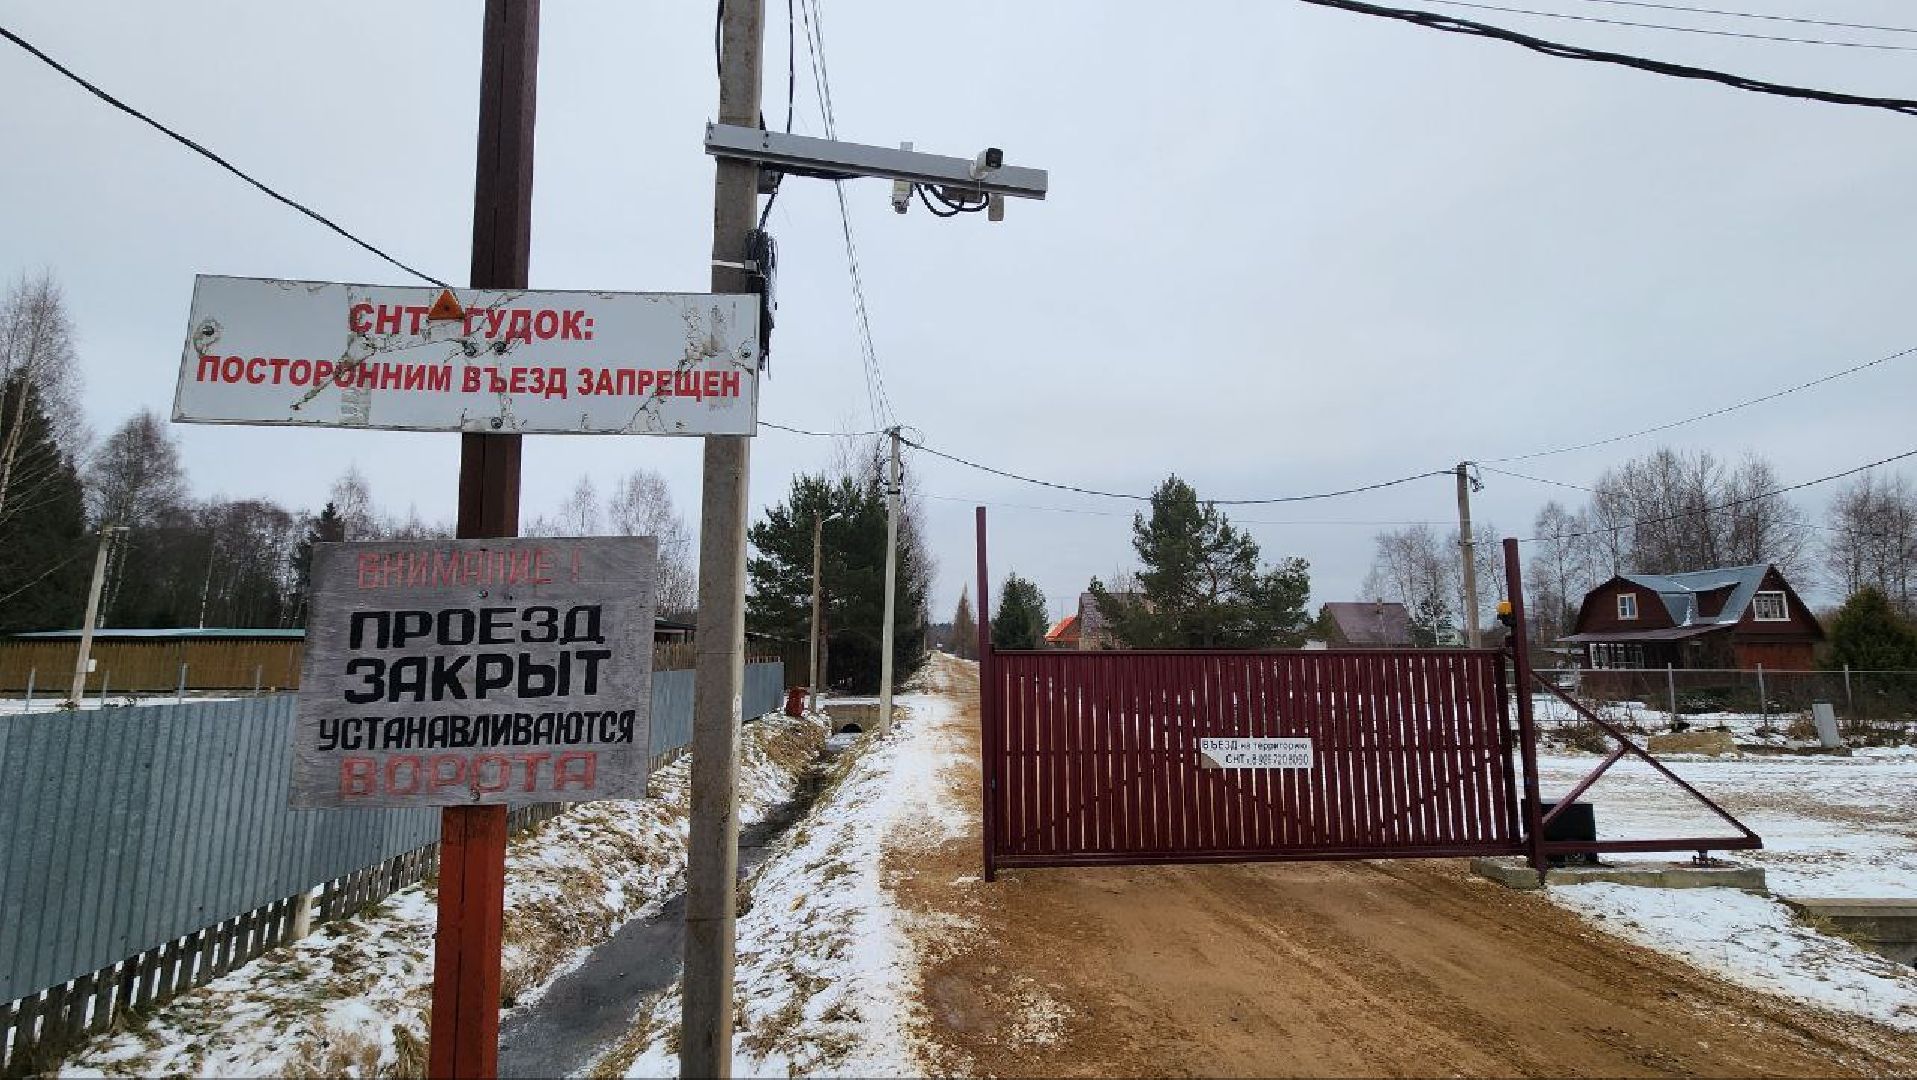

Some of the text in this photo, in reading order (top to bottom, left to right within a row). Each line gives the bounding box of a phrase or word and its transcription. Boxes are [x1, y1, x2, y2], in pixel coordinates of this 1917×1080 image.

[350, 303, 594, 344] СНТ ГУДОК:
[196, 355, 740, 402] ПОСТОРОННИМ ВЪЕЗД ЗАПРЕЩЕН
[350, 605, 605, 649] ПРОЕЗД
[344, 650, 612, 704] ЗАКРЫТ
[318, 709, 636, 751] УСТАНАВЛИВАЮТСЯ
[1202, 741, 1237, 751] ВЪЕЗД
[340, 750, 597, 799] ВОРОТА
[1225, 753, 1245, 763] СНТ
